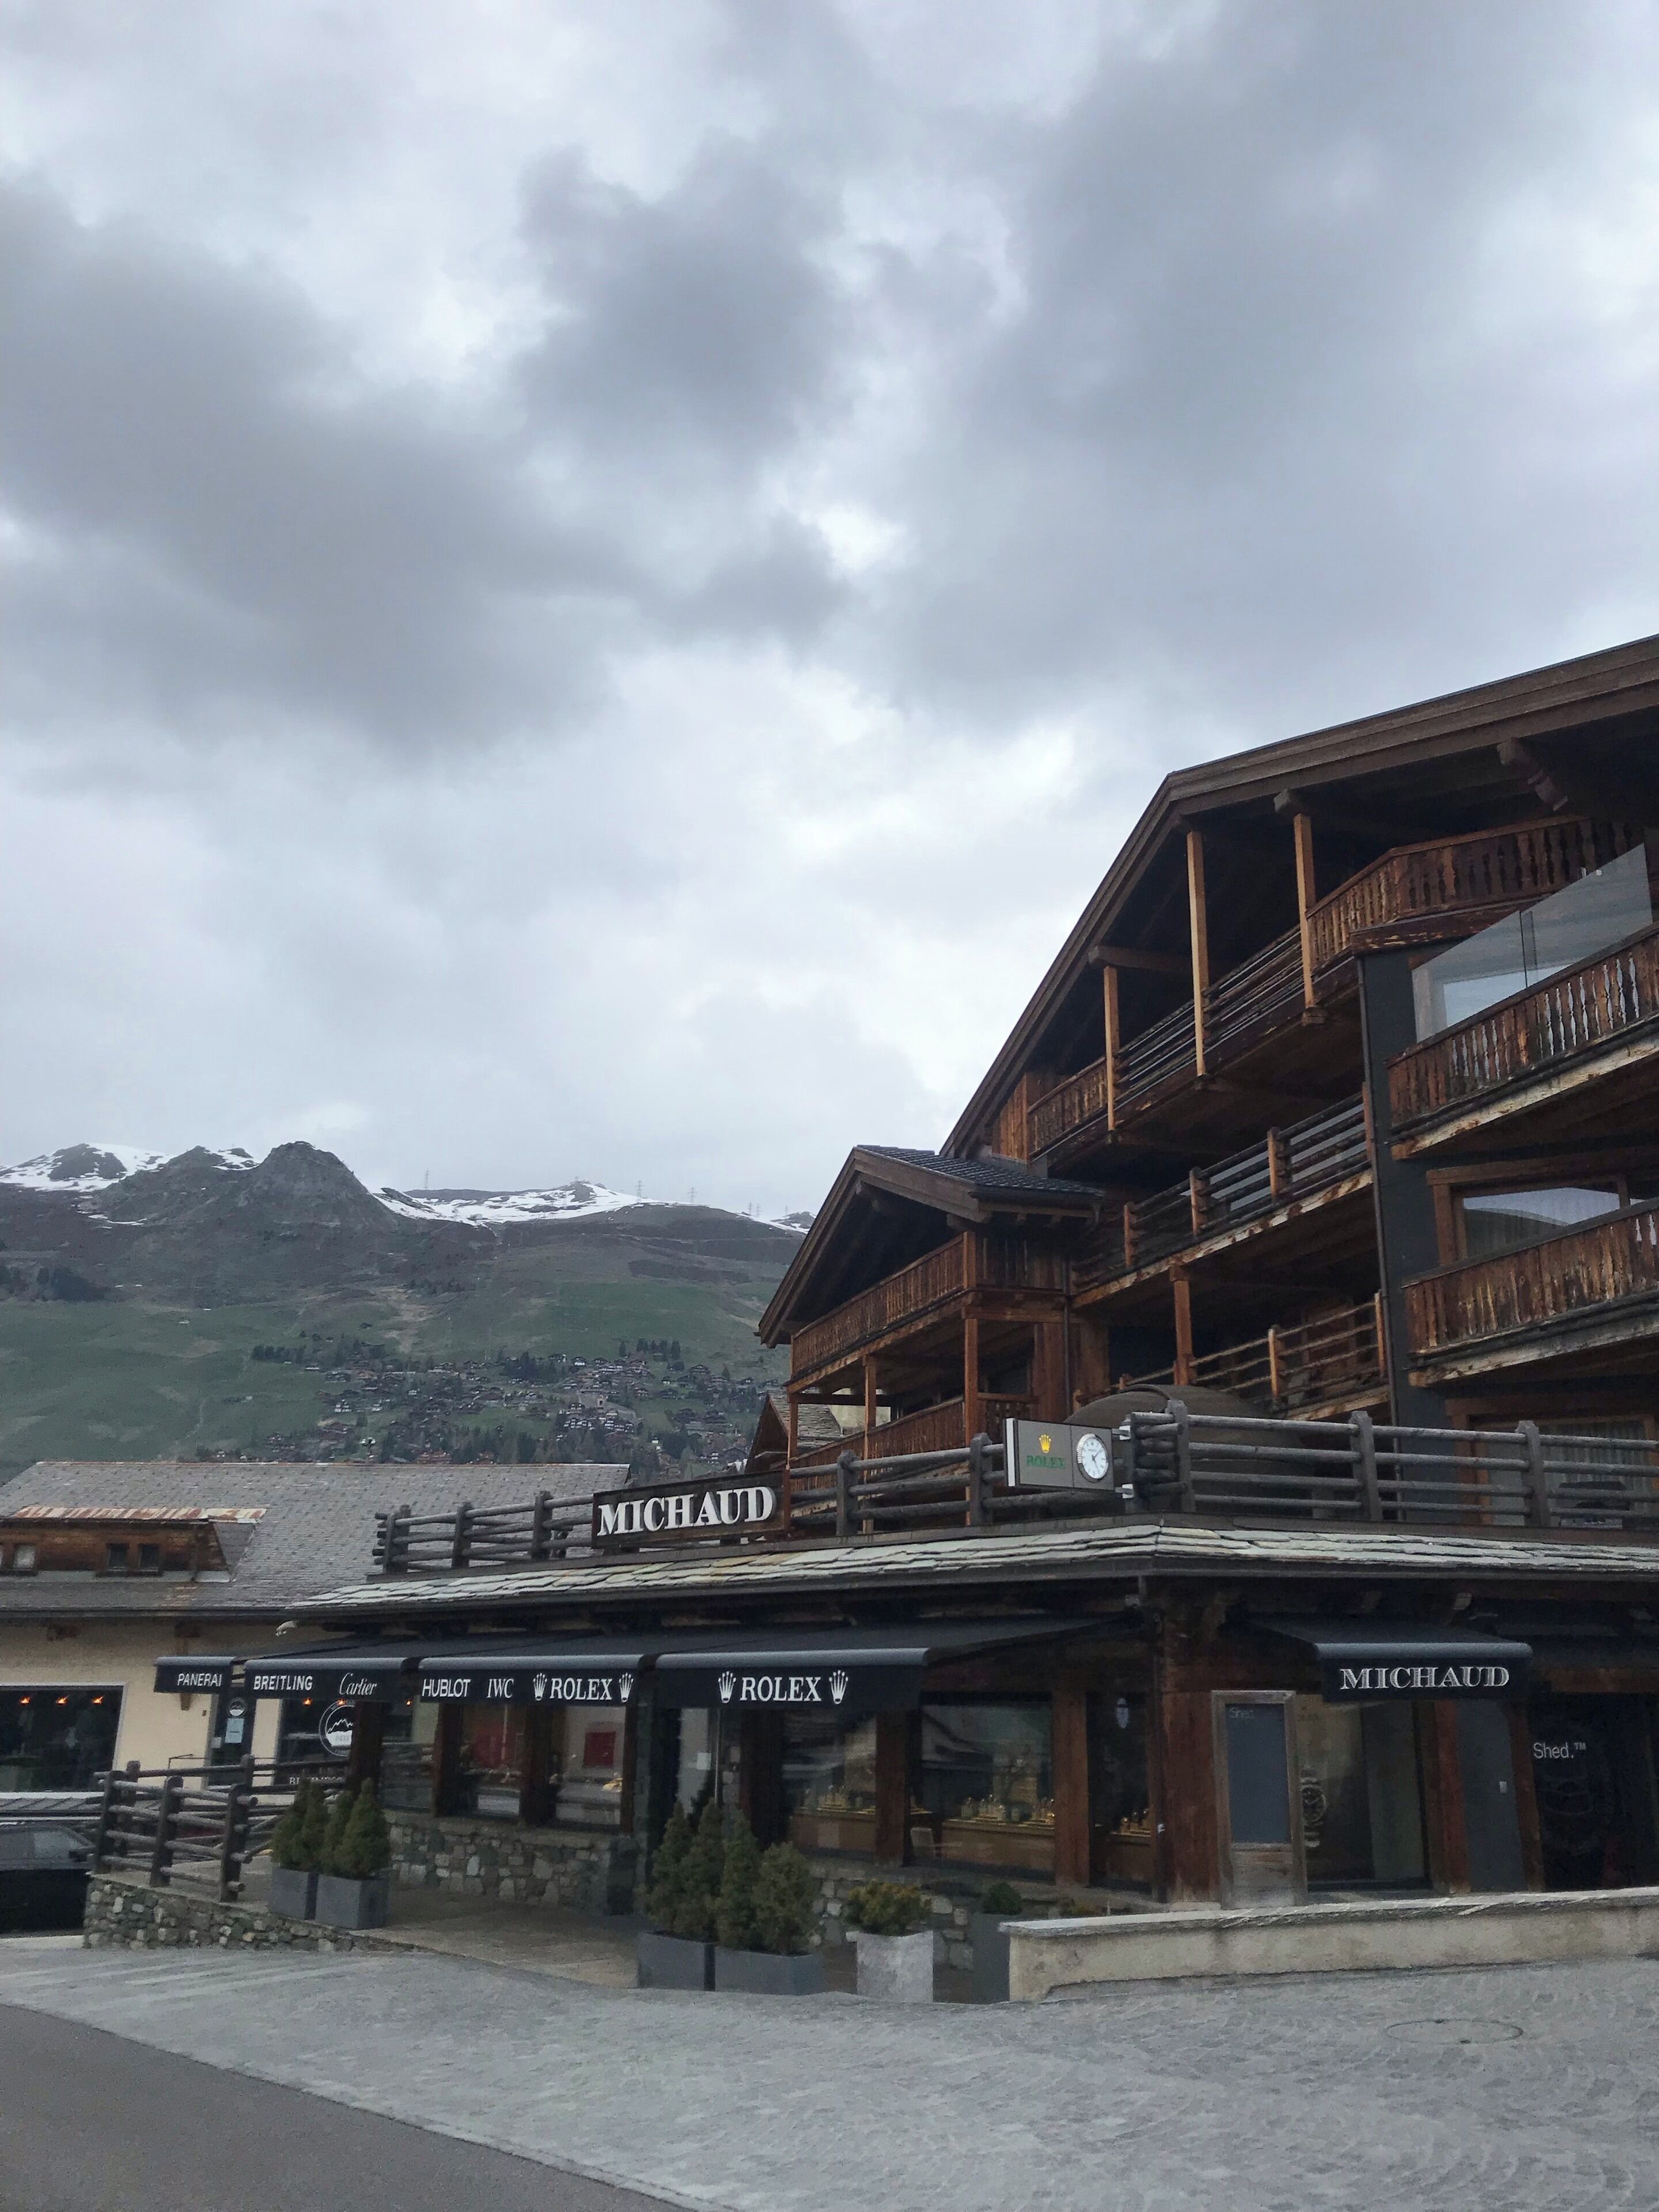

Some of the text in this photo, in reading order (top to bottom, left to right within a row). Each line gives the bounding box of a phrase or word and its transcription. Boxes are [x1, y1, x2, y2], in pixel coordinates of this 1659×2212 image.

[1027, 1456, 1065, 1468] ROLEX
[597, 1486, 775, 1536] MICHAUD
[177, 1673, 222, 1687] PANERAI
[253, 1675, 313, 1691] BREITLING
[339, 1673, 377, 1695] Cartier
[422, 1679, 471, 1698] HUBLOT
[1340, 1666, 1509, 1690] MICHAUD
[487, 1679, 514, 1699] IWC
[550, 1678, 612, 1700] ROLEX
[740, 1676, 822, 1702] ROLEX
